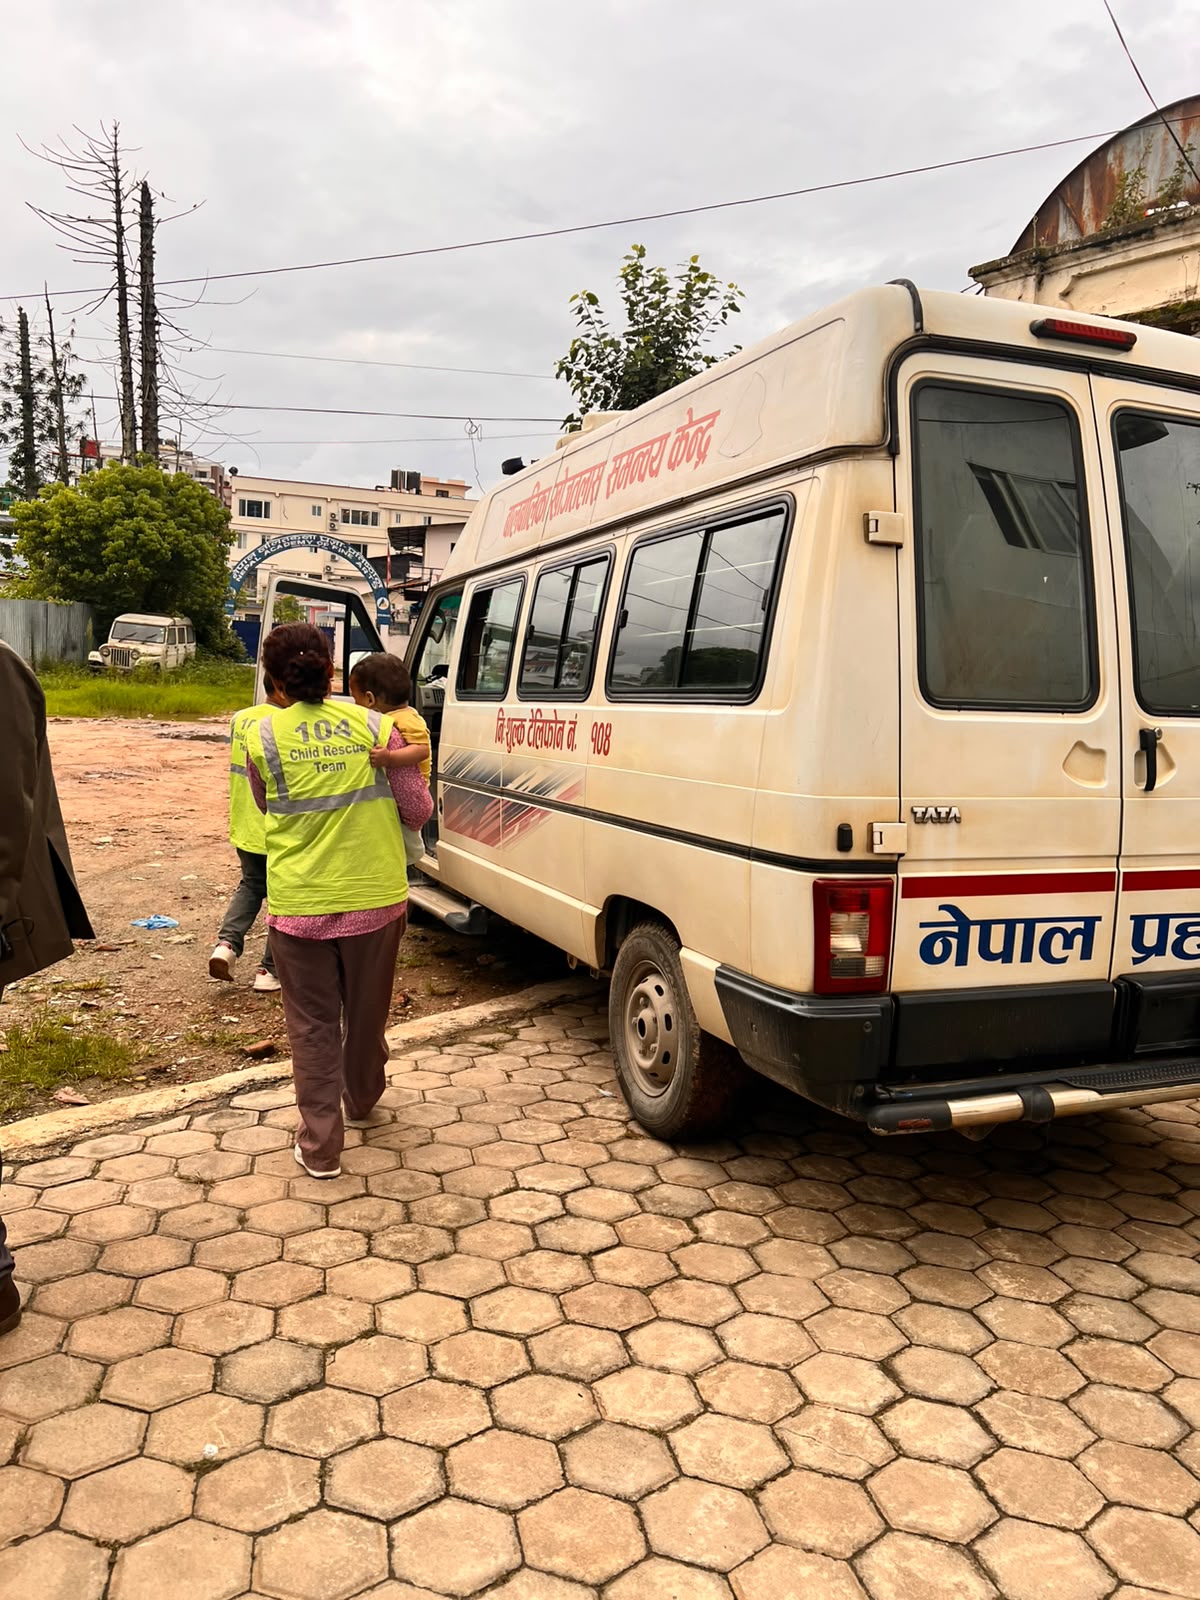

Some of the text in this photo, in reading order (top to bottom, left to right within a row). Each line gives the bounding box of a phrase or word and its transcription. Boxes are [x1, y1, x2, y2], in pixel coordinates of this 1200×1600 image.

[606, 432, 671, 500] समन्वय
[667, 407, 721, 470] केन्द्र
[235, 540, 379, 590] NEPAL ACADEMY OF FINE ARTS
[295, 718, 353, 743] 104
[527, 708, 566, 751] टेलिफोन
[591, 721, 612, 756] १०४
[289, 743, 367, 761] Child Rescue
[313, 760, 346, 774] Team
[911, 806, 962, 824] TATA
[919, 904, 1102, 967] नेपाल
